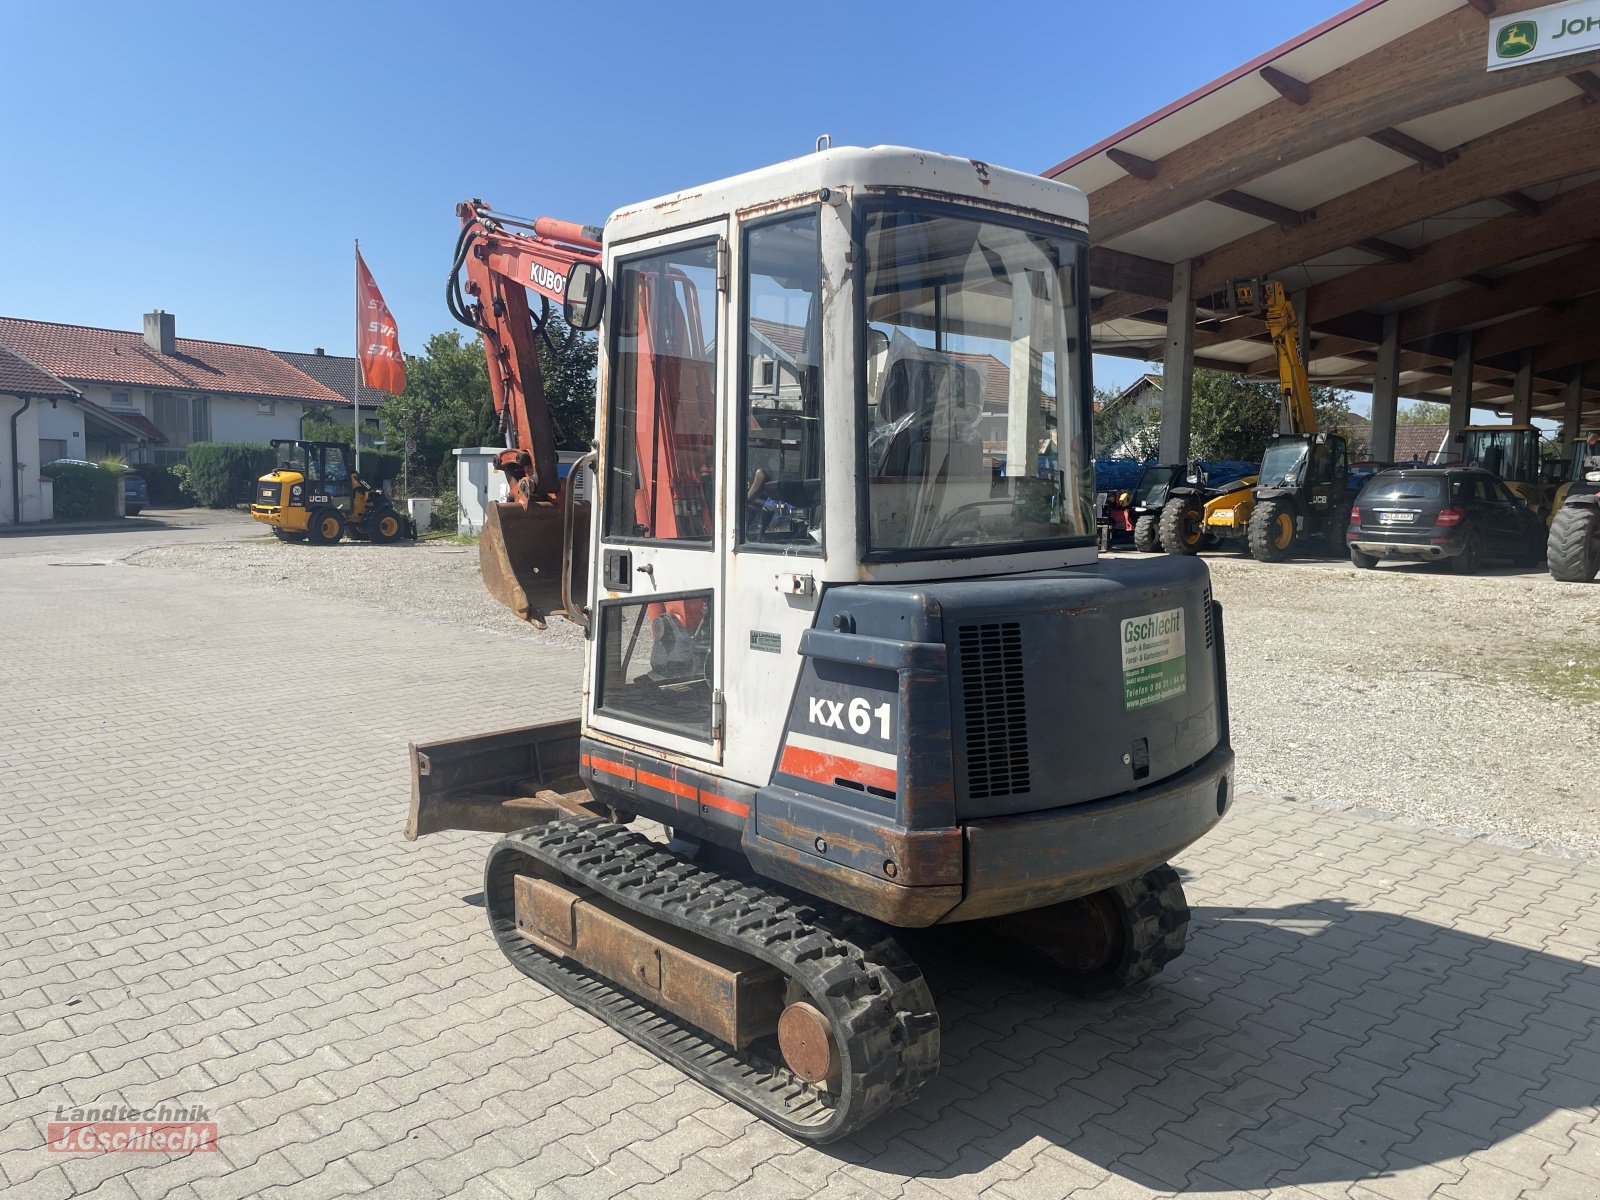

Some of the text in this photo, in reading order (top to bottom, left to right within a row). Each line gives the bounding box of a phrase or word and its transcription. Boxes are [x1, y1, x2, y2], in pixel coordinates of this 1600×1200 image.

[309, 495, 328, 503] JCB
[1312, 495, 1327, 504] JCB
[1124, 611, 1180, 643] Gschlecht
[1126, 686, 1148, 698] Telefon
[809, 696, 891, 740] KX61
